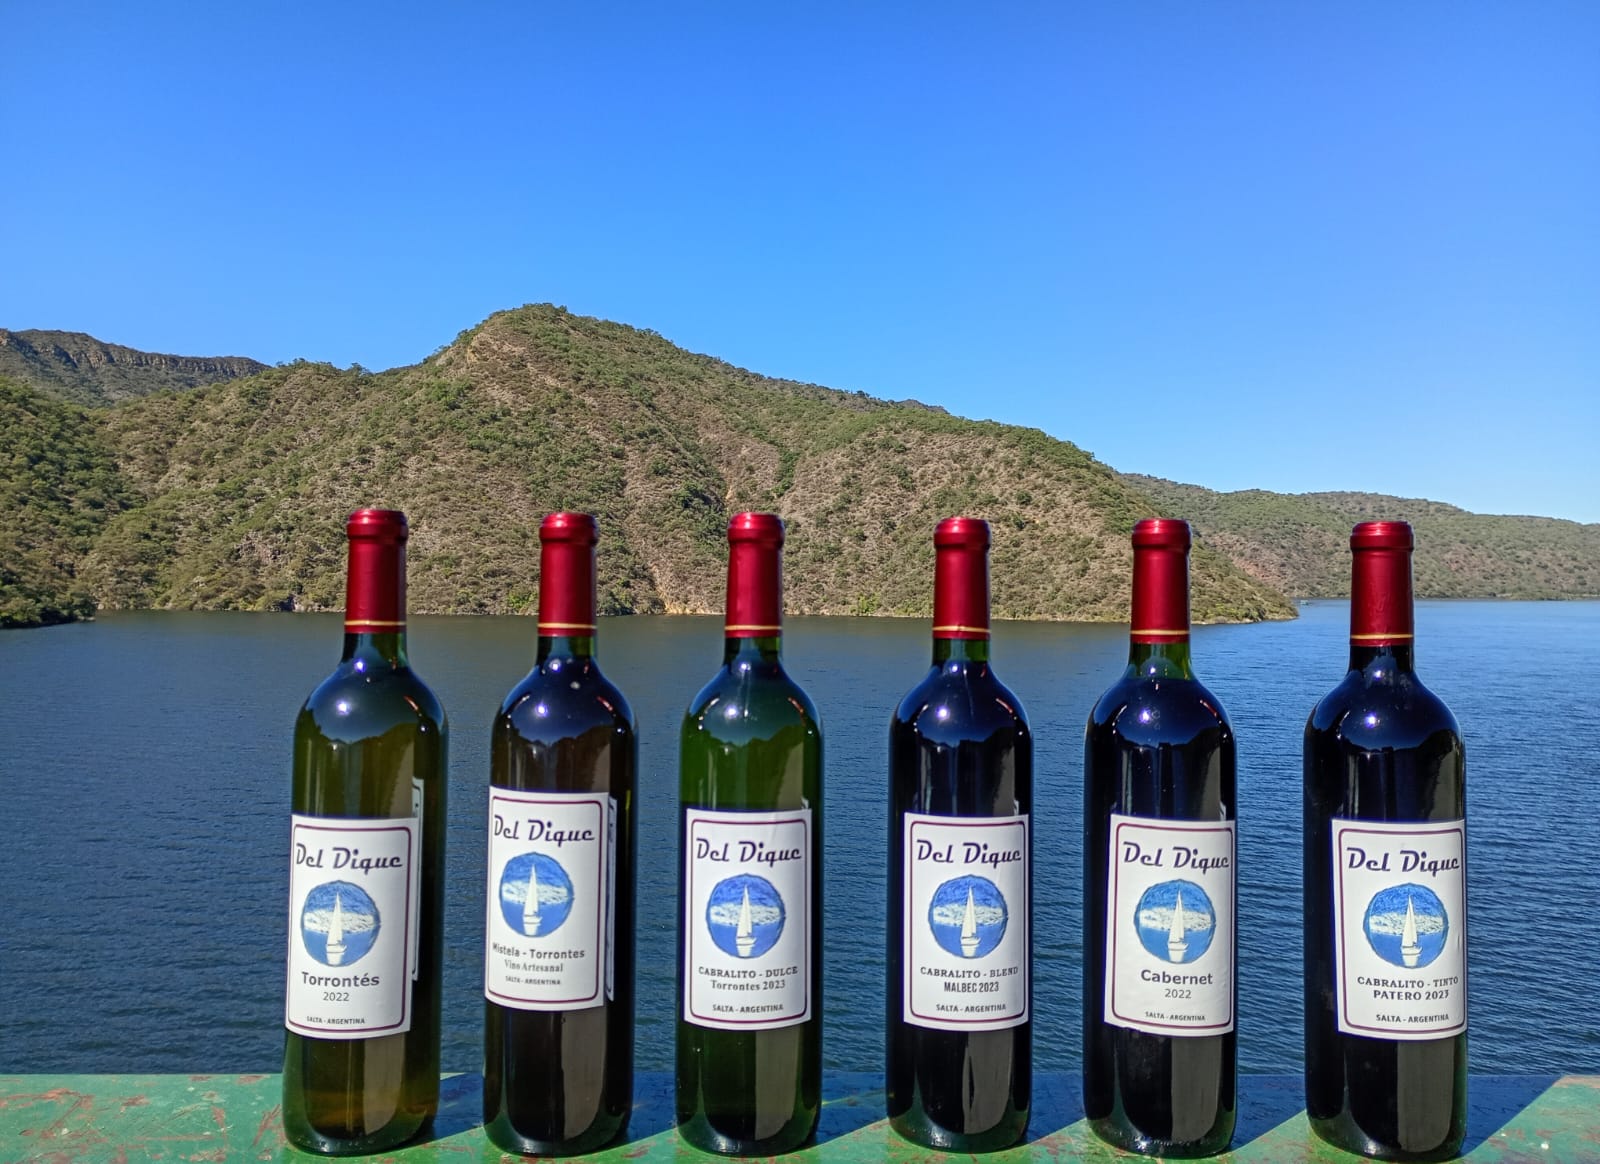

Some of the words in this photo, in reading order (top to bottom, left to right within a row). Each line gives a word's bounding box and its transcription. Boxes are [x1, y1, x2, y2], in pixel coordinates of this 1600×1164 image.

[494, 814, 519, 839] Del
[528, 819, 595, 847] Dique
[696, 838, 729, 862] Del
[739, 841, 802, 867] Dique
[917, 839, 954, 863] Del
[963, 842, 1021, 869] Dique
[1123, 841, 1163, 867] Del
[1173, 846, 1229, 875] Dique
[296, 843, 323, 868] Del
[332, 847, 403, 875] Dique
[1347, 847, 1390, 872] Del
[1400, 850, 1459, 877] Dique
[529, 949, 584, 959] Torrontes
[504, 959, 521, 970] Vino
[522, 962, 563, 972] Artesanal
[698, 966, 756, 978] CABRALITO
[765, 966, 798, 978] DULCE
[921, 967, 980, 978] CABRALITO
[990, 966, 1018, 978] BLEND
[1141, 969, 1213, 985] Cabernet
[302, 972, 380, 987] Torrontés
[710, 979, 760, 991] Torrontes
[762, 980, 785, 990] 2023
[1358, 976, 1424, 988] CABRALITO
[1433, 976, 1458, 987] TINTO
[944, 981, 977, 993] MALBEC
[979, 981, 999, 992] 2023
[323, 992, 349, 1001] 2022
[1164, 989, 1191, 999] 2022
[1373, 990, 1421, 1000] PATERO
[1425, 990, 1449, 1000] 2023
[712, 1004, 734, 1012] SALTA
[740, 1004, 783, 1013] ARGENTINA
[936, 1004, 958, 1012] SALTA
[965, 1004, 1006, 1012] ARGENTINA
[1145, 1011, 1165, 1020] SALTA
[1376, 1014, 1402, 1022] SALTA
[1408, 1014, 1449, 1023] ARGENTINA
